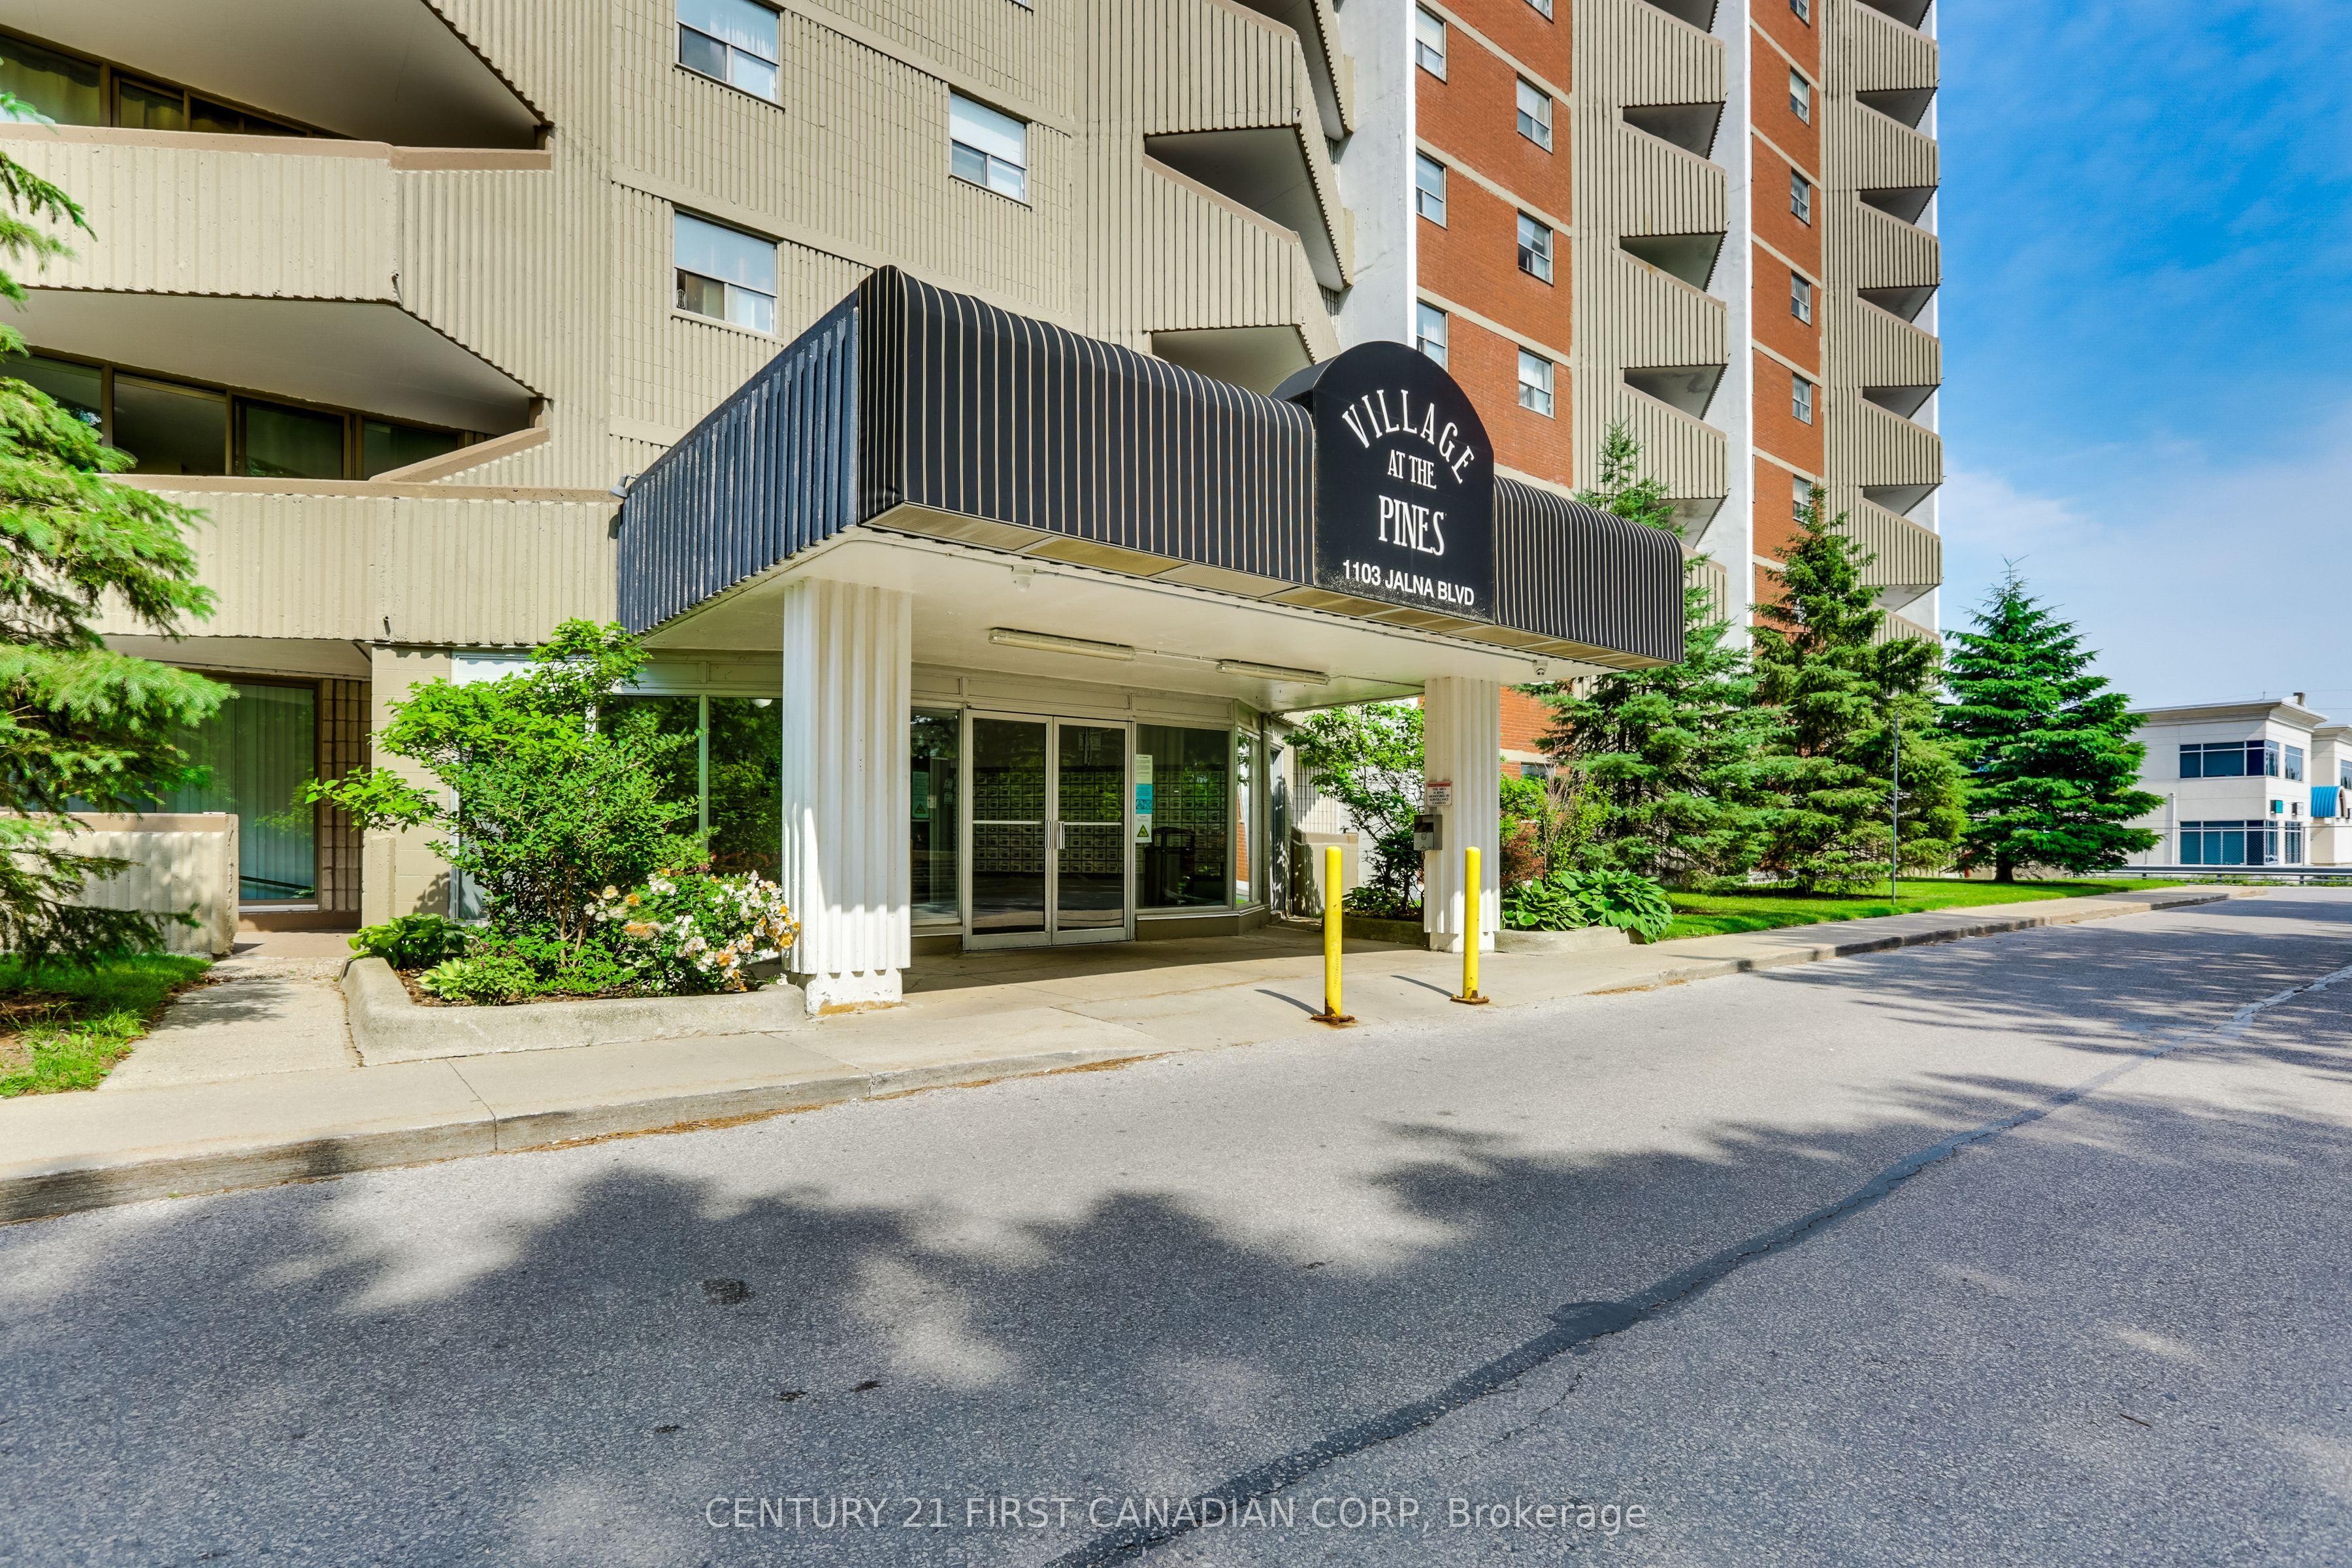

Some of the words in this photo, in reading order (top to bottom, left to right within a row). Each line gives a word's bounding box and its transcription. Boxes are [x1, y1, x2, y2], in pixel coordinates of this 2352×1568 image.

[1342, 389, 1475, 483] VILLAGE
[1387, 449, 1405, 479] AT
[1409, 455, 1437, 489] THE
[1378, 495, 1445, 556] PINES
[1343, 559, 1381, 586] 1103
[1385, 569, 1434, 598] JALNA
[1438, 580, 1475, 606] BLVD
